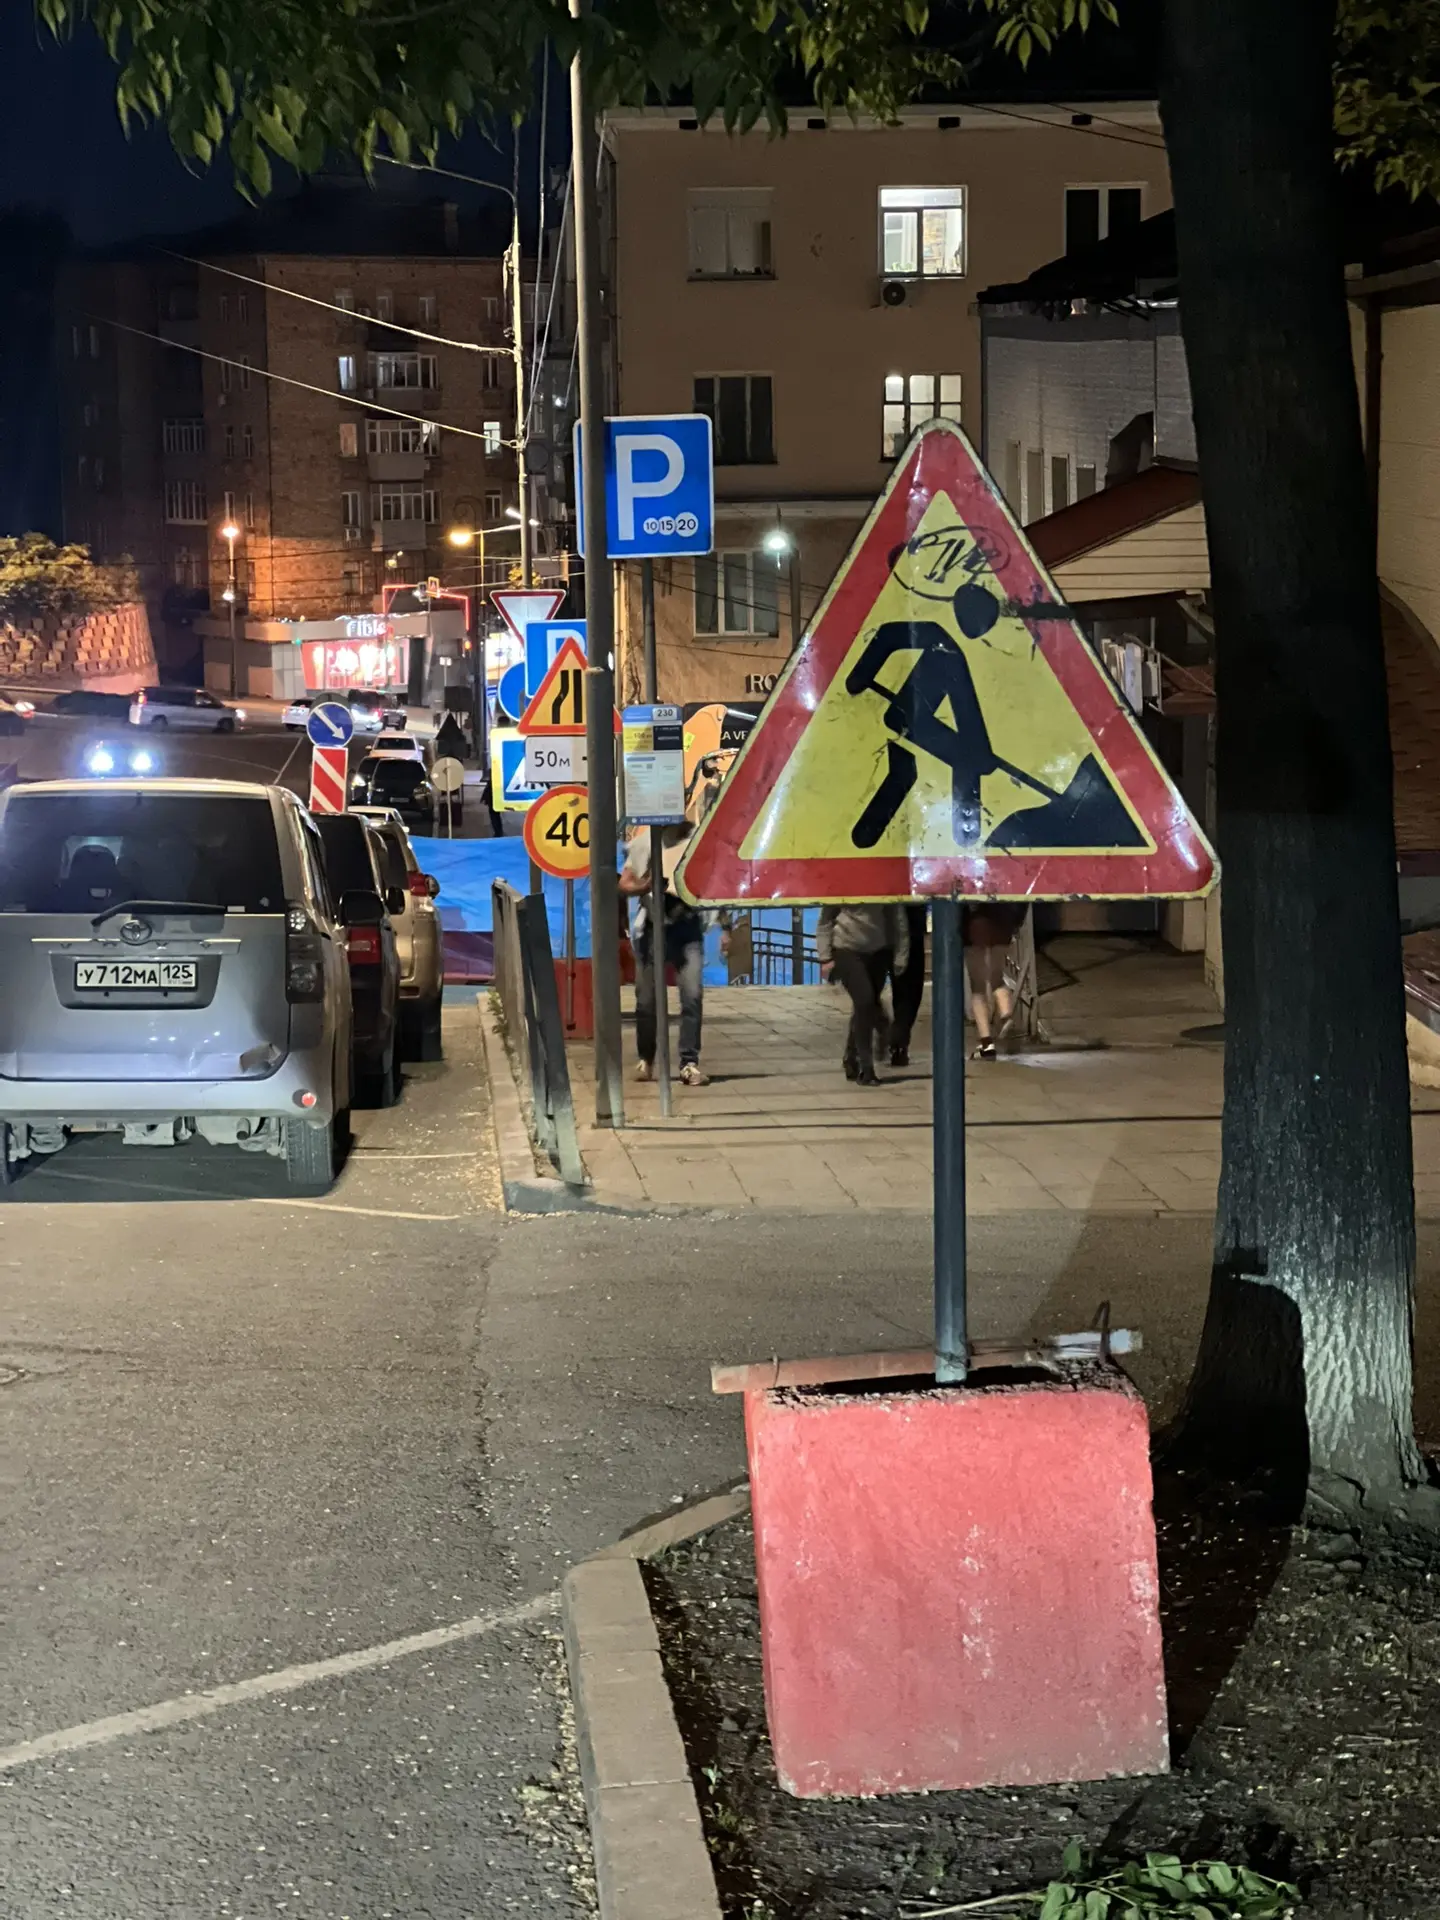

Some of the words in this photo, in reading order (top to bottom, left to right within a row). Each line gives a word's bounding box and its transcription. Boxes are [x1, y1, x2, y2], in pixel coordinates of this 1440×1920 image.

[615, 433, 686, 542] P
[646, 521, 658, 531] 10
[661, 519, 674, 531] 15
[677, 518, 697, 532] 20
[657, 709, 674, 717] 230
[545, 812, 590, 849] 40
[162, 965, 191, 979] 125
